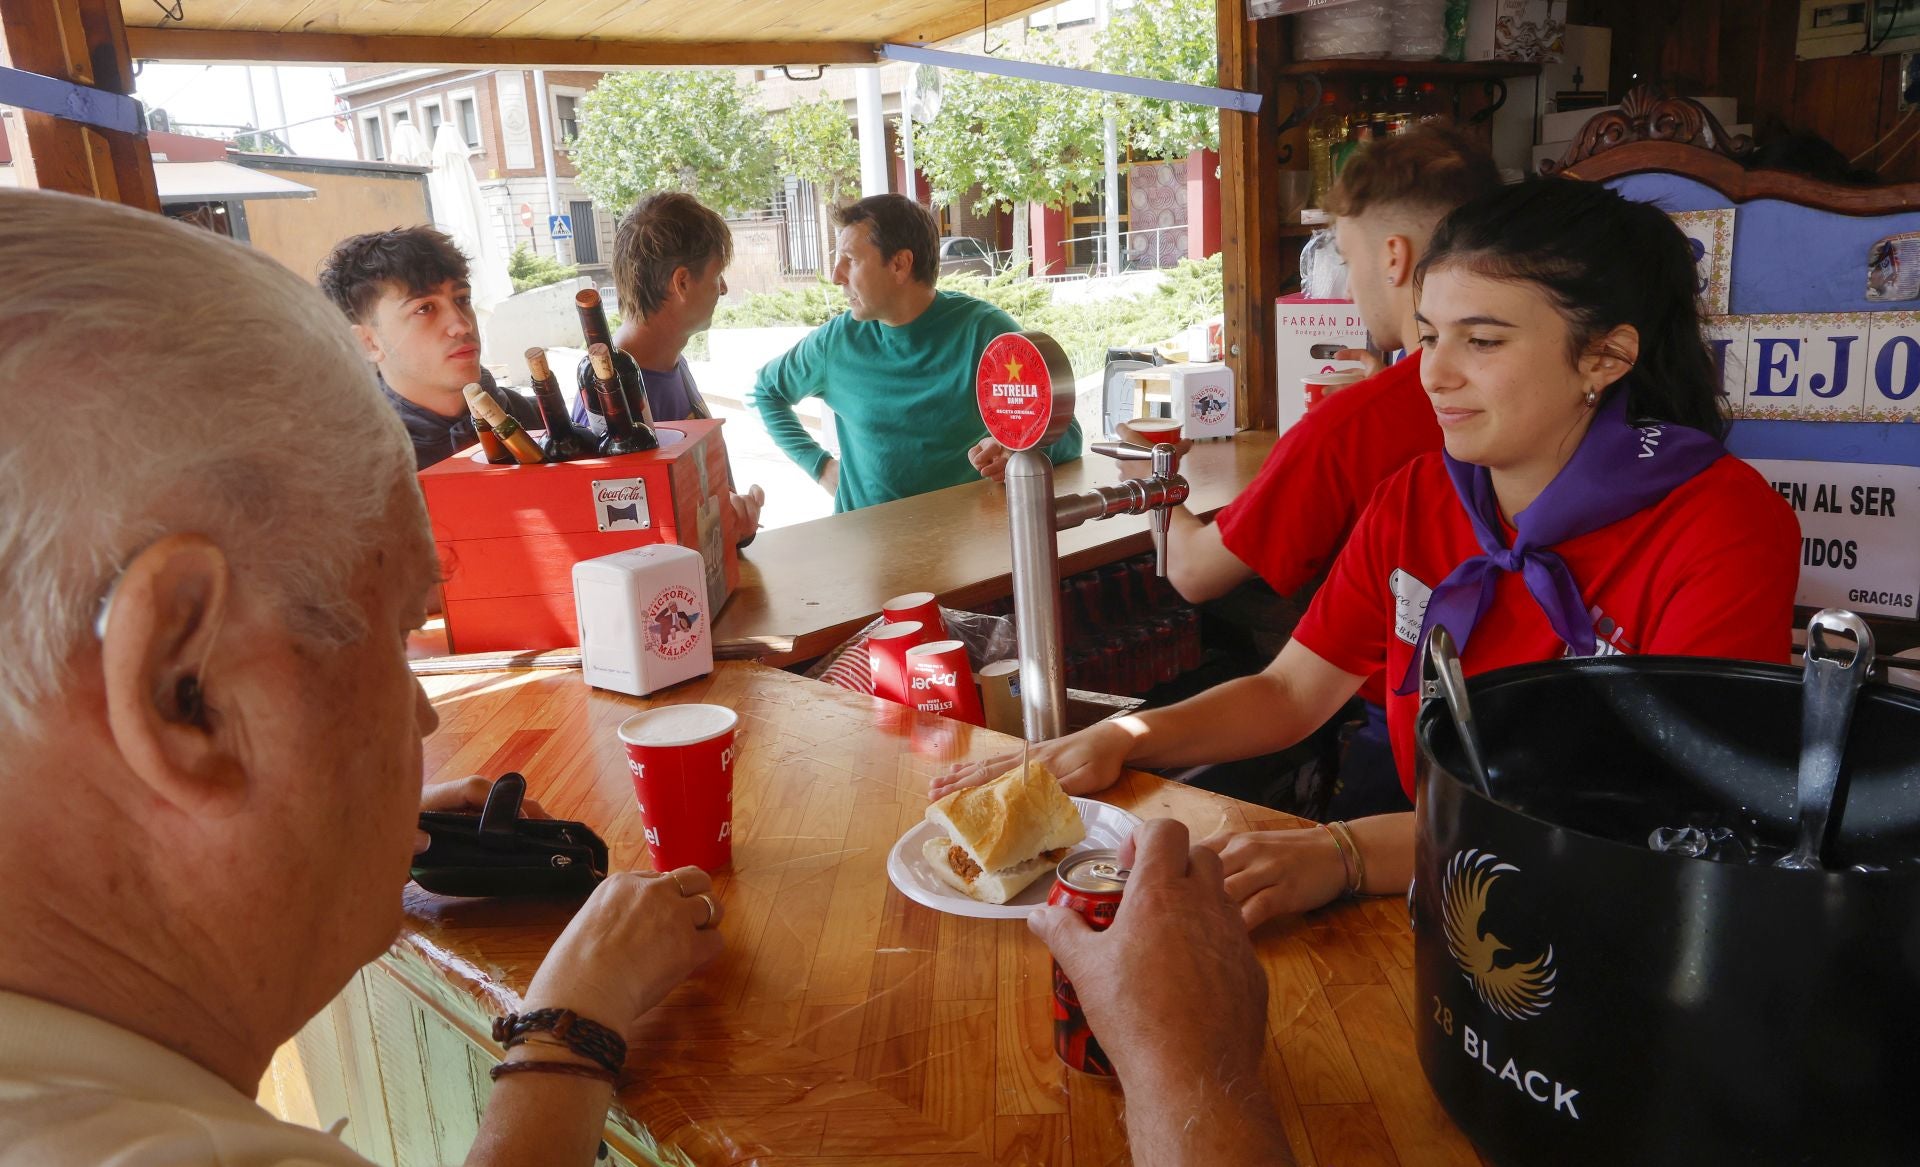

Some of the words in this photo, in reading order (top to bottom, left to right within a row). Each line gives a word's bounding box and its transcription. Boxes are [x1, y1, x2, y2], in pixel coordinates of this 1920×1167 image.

[1282, 314, 1337, 327] FARRÁN
[1346, 316, 1361, 327] DI
[1709, 335, 1920, 401] IEJO
[992, 383, 1038, 397] ESTRELLA
[1007, 397, 1024, 405] DAMM
[1638, 425, 1664, 458] viv
[598, 486, 641, 502] Coca-Cola
[1813, 484, 1843, 513] AL
[1850, 485, 1896, 517] SER
[650, 590, 695, 617] VICTORIA
[1848, 589, 1913, 608] GRACIAS
[658, 634, 697, 656] MÁLAGA
[917, 700, 953, 712] ESTRELLA
[1433, 995, 1453, 1036] 28
[1464, 1024, 1580, 1120] BLACK
